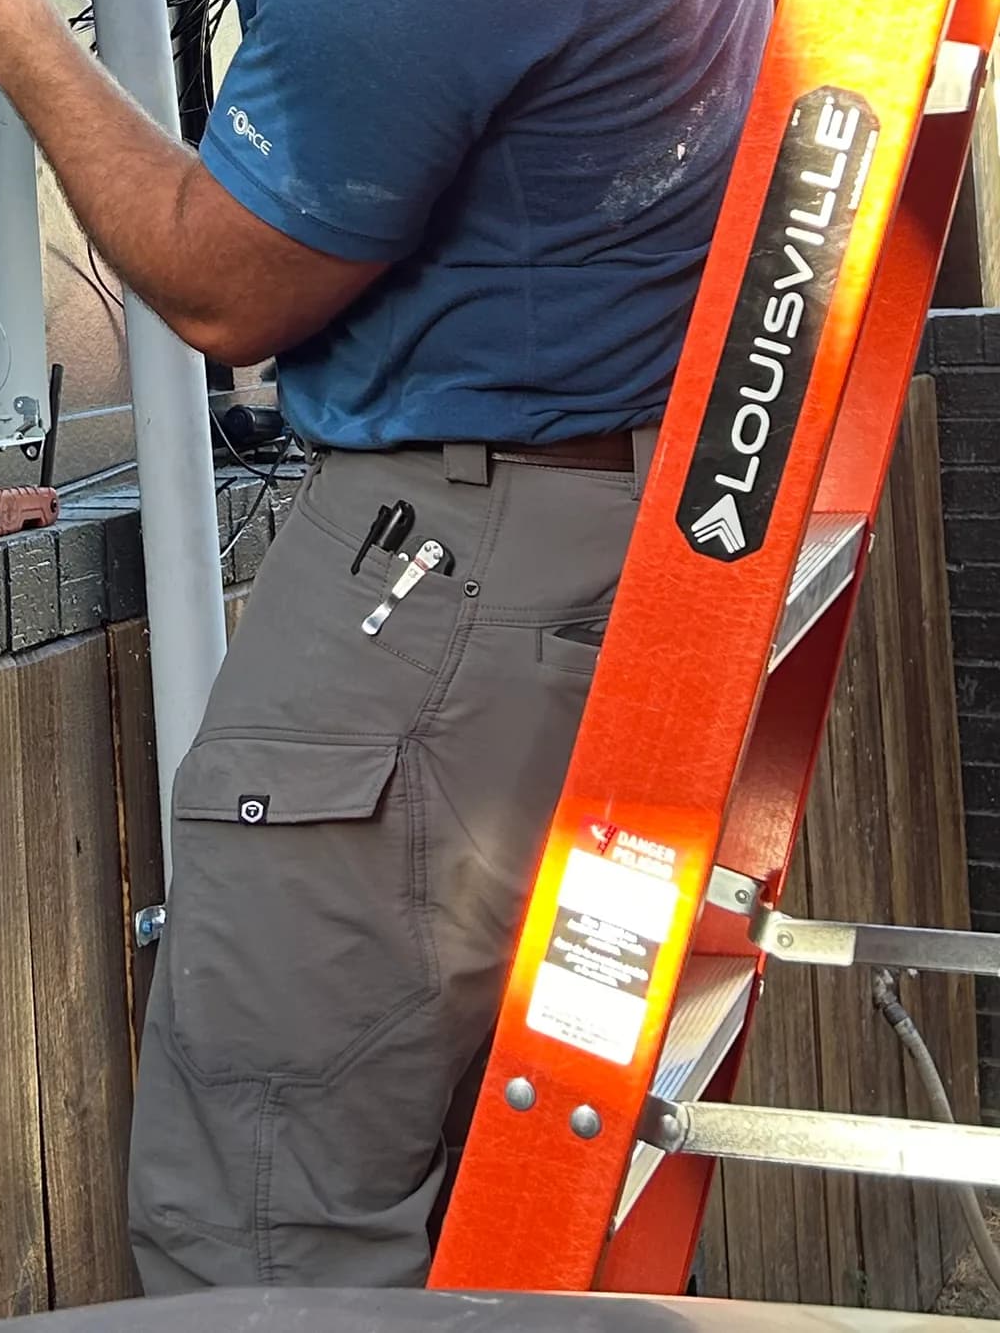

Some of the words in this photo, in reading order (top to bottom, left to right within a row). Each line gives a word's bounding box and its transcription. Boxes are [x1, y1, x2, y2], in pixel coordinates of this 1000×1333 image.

[226, 106, 273, 156] FORCE
[715, 104, 860, 493] LOUISVILLE
[617, 830, 676, 865] DANGER
